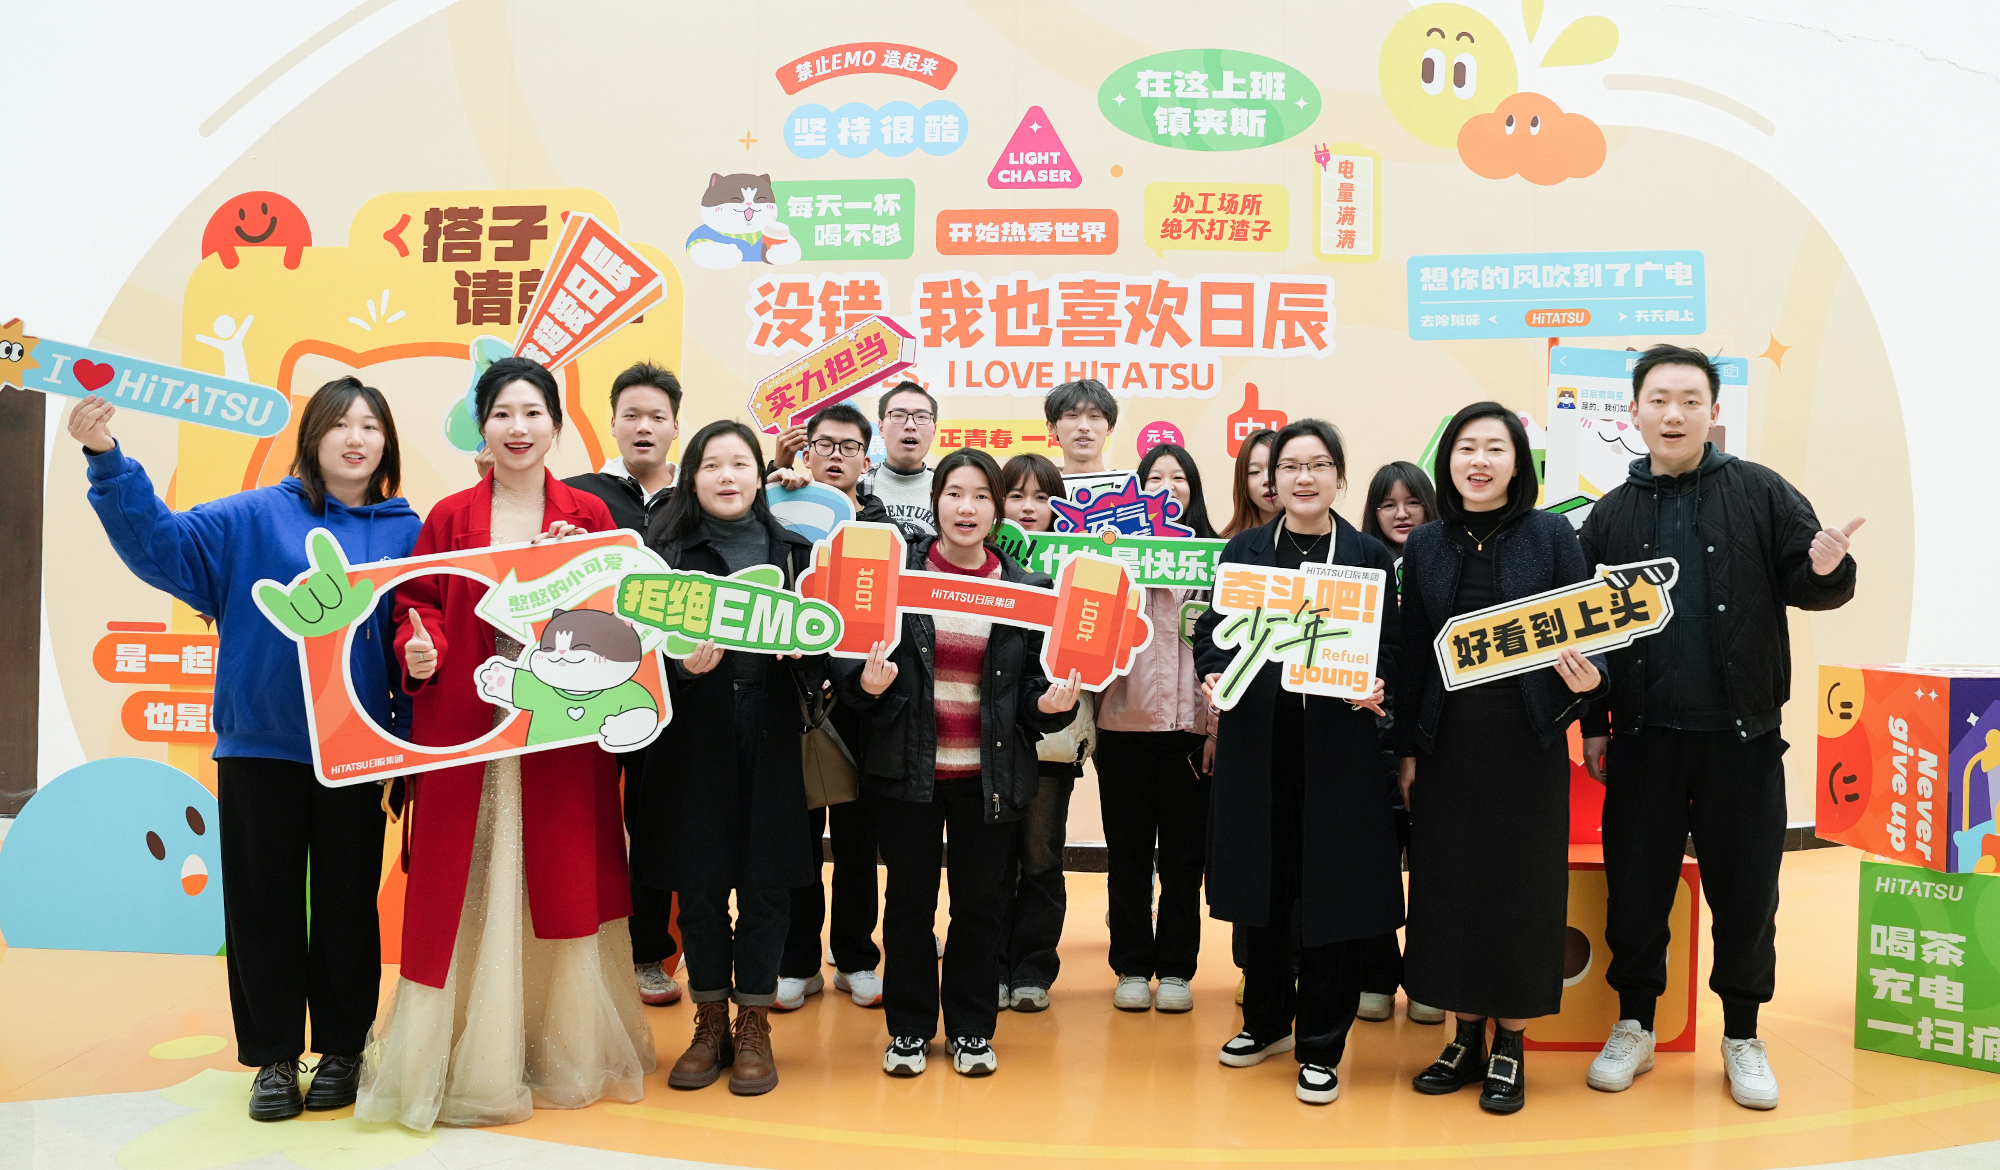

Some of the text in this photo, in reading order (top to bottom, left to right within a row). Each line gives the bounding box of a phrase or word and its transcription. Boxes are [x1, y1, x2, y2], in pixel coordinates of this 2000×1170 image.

[881, 50, 939, 76] 造起来
[1135, 69, 1286, 100] 在这上班
[794, 114, 960, 146] 坚持很酷
[1153, 106, 1267, 137] 镇夹斯
[1009, 152, 1061, 165] LIGHT
[997, 169, 1072, 183] CHASER
[787, 193, 902, 218] 每天一杯
[1172, 192, 1263, 216] 办工场所
[1336, 160, 1357, 250] 电量满满
[423, 205, 548, 262] 搭子
[814, 222, 902, 247] 喝不够
[949, 221, 1107, 243] 开始热爱世界
[1160, 218, 1272, 242] 绝不打渣子
[1420, 262, 1694, 292] 想你的风吹到了广电
[1420, 313, 1481, 327] 去除班味
[1532, 312, 1585, 325] HiTATSU
[1635, 310, 1694, 323] 天天向上
[765, 331, 888, 419] 实力担当
[948, 361, 956, 388] I
[966, 361, 1054, 389] LOVE
[43, 353, 274, 427] I HiTATSU
[1581, 401, 1630, 413] 是的，我们如
[940, 428, 1014, 449] 正青春
[1146, 429, 1177, 443] 元气
[854, 567, 875, 612] 100t
[1075, 597, 1100, 643] 100t
[1452, 589, 1651, 670] 好看到上头
[1321, 647, 1370, 665] Refuel
[1288, 663, 1369, 693] young
[1886, 714, 1915, 852] give up
[1915, 747, 1938, 862] Never
[1875, 876, 1964, 902] HiTATSU
[1870, 924, 1967, 968] 喝茶
[1868, 967, 1964, 1013] 充电
